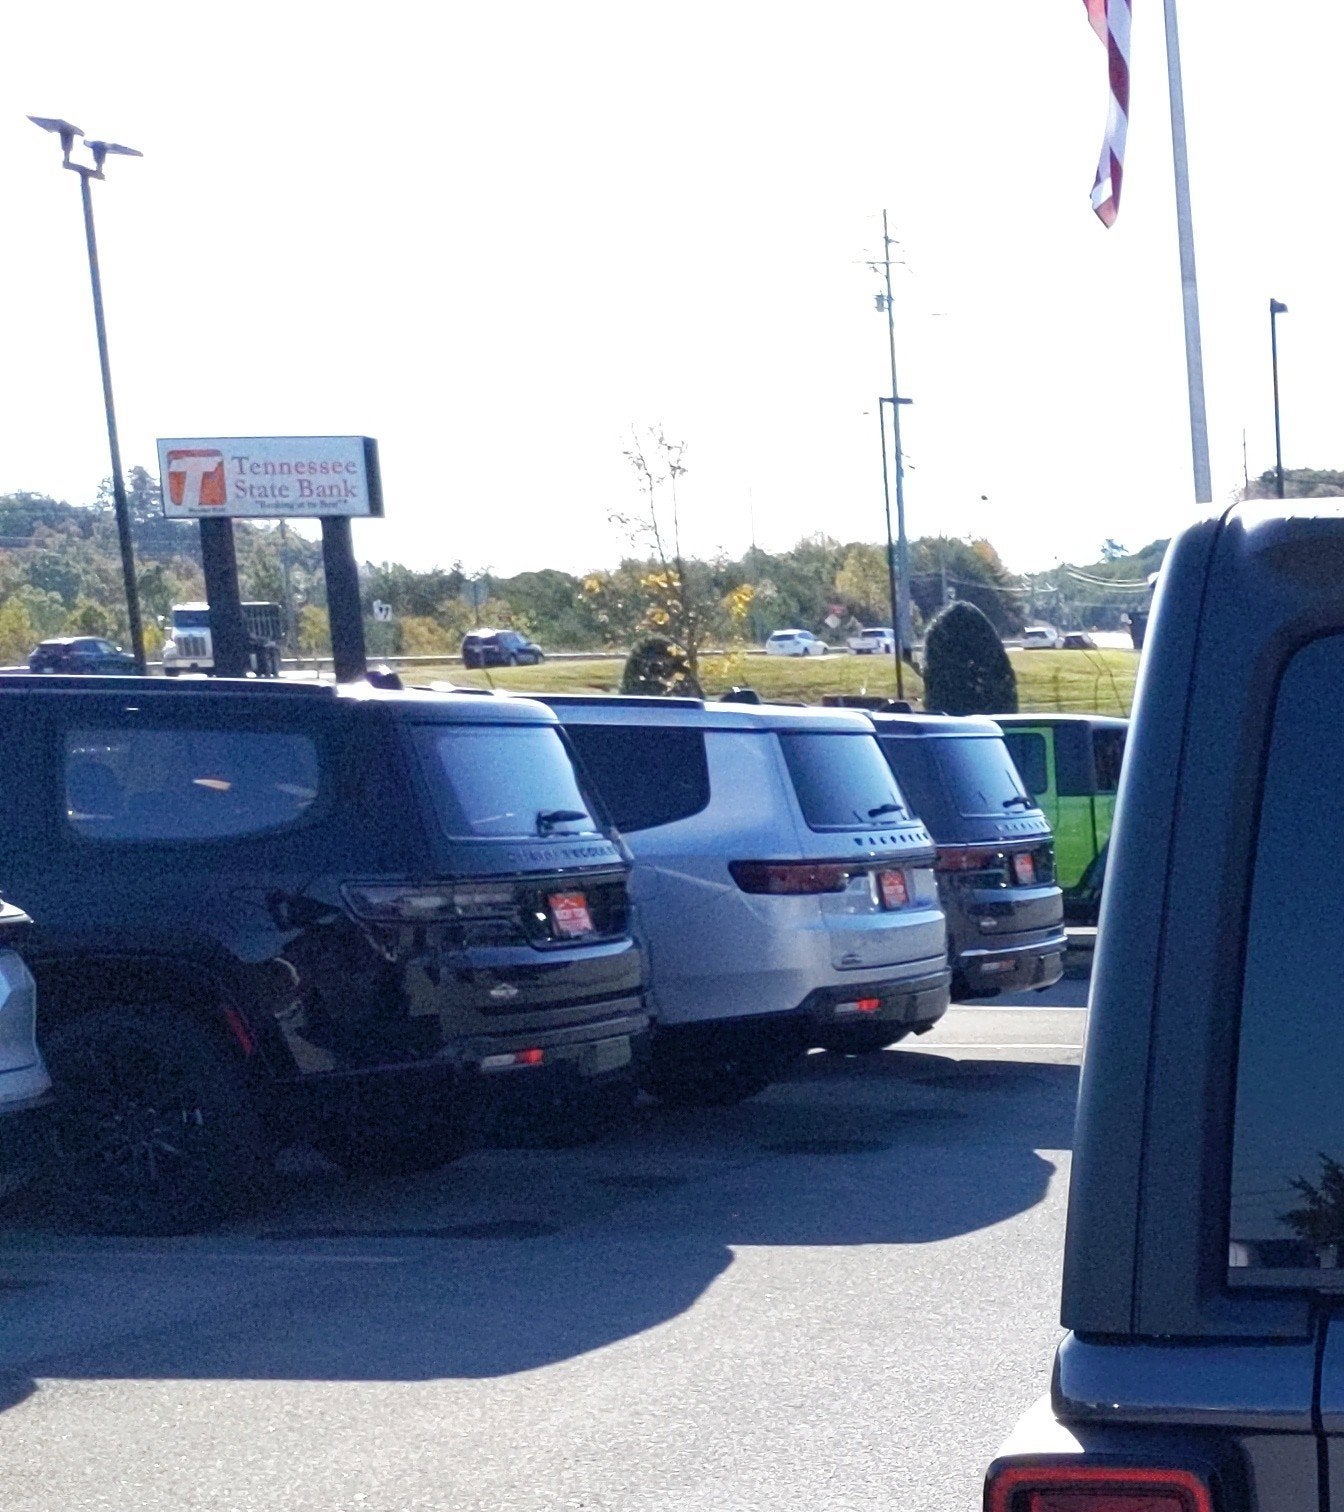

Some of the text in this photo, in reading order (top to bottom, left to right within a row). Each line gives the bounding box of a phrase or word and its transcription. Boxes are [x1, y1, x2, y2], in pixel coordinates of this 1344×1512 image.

[231, 456, 358, 475] Tennessee
[233, 479, 358, 499] State Bank
